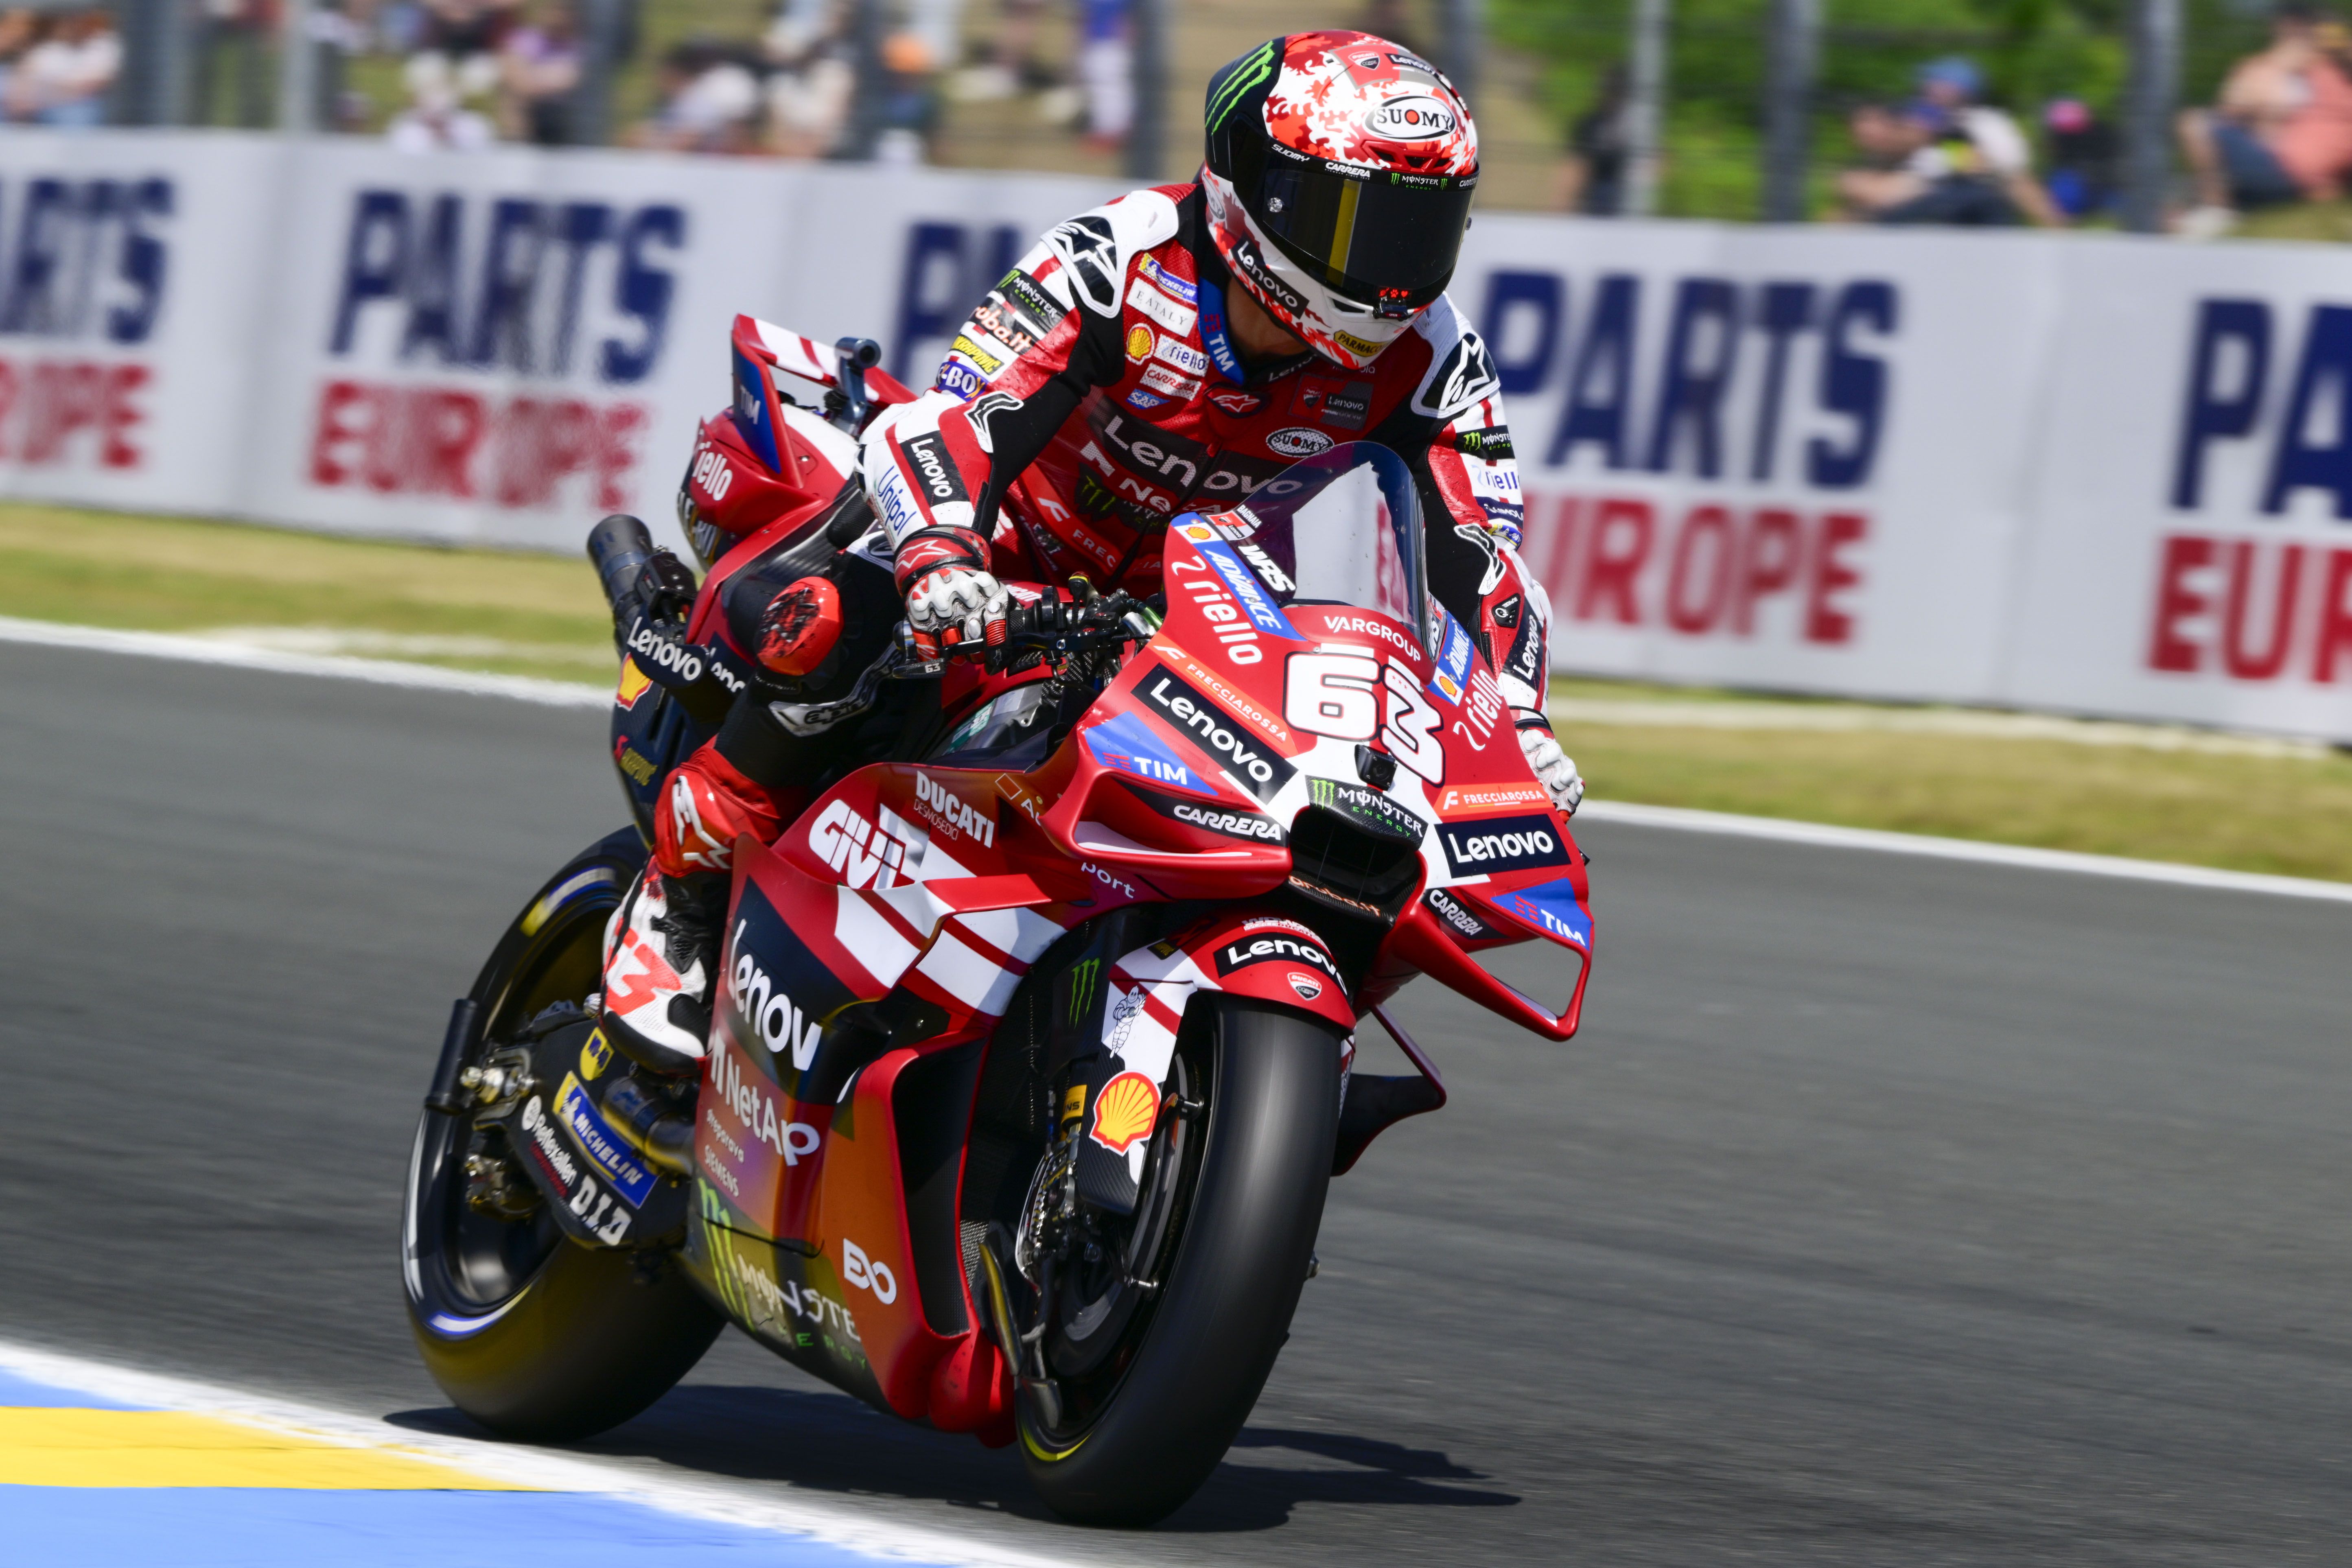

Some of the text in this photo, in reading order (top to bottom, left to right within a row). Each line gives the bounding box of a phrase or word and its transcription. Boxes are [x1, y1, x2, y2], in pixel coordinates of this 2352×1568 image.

[1376, 108, 1451, 131] SUOMY
[1271, 143, 1311, 162] SUOMY
[1326, 162, 1370, 178] CARRERA
[1237, 241, 1298, 308] Lenovo
[974, 306, 1032, 352] uba.it
[1136, 291, 1188, 326] EATALY
[1169, 346, 1206, 371] riello
[1209, 333, 1235, 372] TIM
[1147, 369, 1196, 393] CARRERA
[1481, 272, 1899, 490] PARTS
[1274, 433, 1328, 453] SUOMY
[1482, 432, 1511, 445] MONSTE
[692, 441, 733, 501] iello
[910, 438, 953, 497] Lenovo
[1486, 470, 1520, 490] riell
[877, 465, 917, 536] Unipol
[1236, 504, 1262, 529] BAGNAIA
[1228, 525, 1243, 538] Lenovo
[1204, 549, 1282, 629] ADVANCE
[1523, 490, 1872, 646] UROPE
[1183, 581, 1262, 665] riello
[1324, 616, 1421, 662] VARGROUP
[627, 616, 702, 680] Lenovo
[924, 663, 941, 674] 63
[1447, 623, 1470, 681] ADVANCE
[1187, 663, 1287, 742] FRECCIAROSSA
[1282, 651, 1446, 788] 63
[1467, 669, 1504, 739] riello
[1150, 677, 1273, 782] Lenovo
[1134, 756, 1188, 785] TIM
[913, 798, 960, 841] DESMOSEDICI
[916, 770, 995, 849] DUCATI
[1337, 787, 1423, 838] MONSTER
[1464, 789, 1545, 805] FRECCIAROSSA
[808, 798, 904, 890] GIVI
[1173, 805, 1282, 841] CARRERA
[1351, 806, 1411, 838] ENERGY
[1448, 830, 1554, 864] Lenovo
[1429, 888, 1483, 937] CARRERA
[1540, 908, 1586, 947] TIM
[1228, 940, 1348, 996] Lenovo
[1291, 974, 1319, 987] DUCATI
[727, 918, 860, 1104] Lenov
[574, 1112, 644, 1185] MICHELIN
[704, 1144, 740, 1197] SIEMENS
